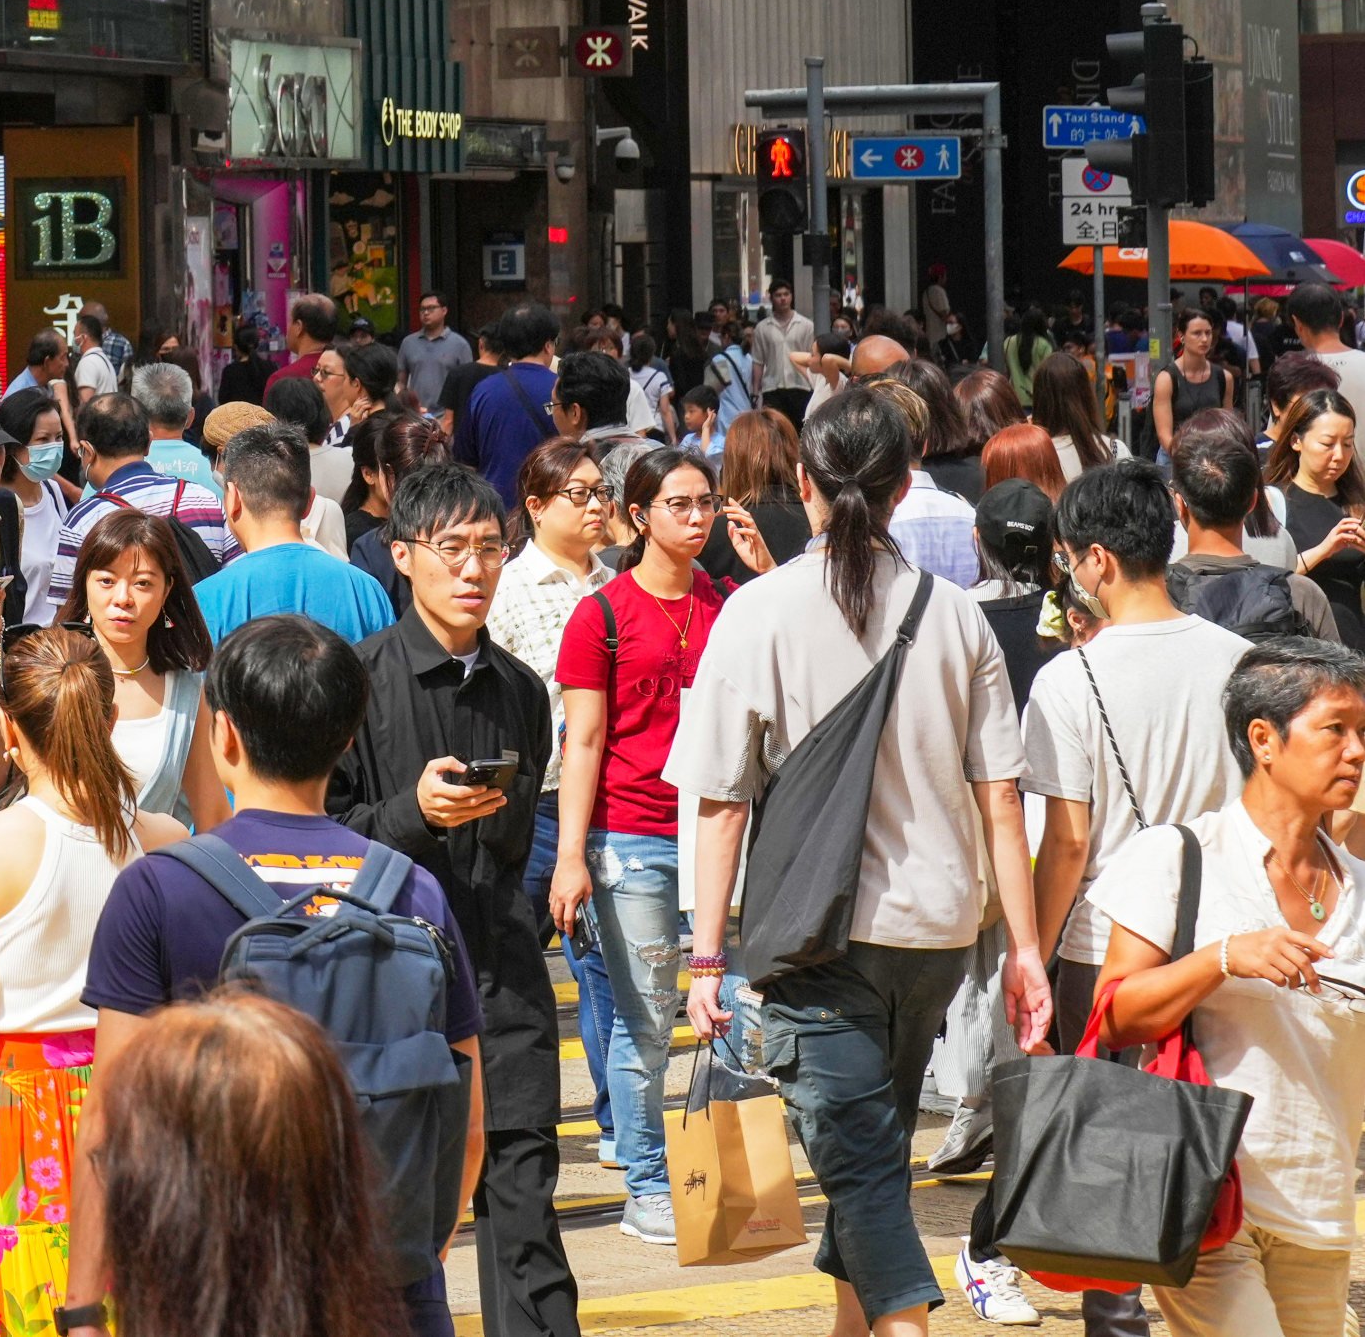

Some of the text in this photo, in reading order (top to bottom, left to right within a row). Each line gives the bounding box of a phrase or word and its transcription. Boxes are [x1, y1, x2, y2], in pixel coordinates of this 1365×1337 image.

[397, 109, 461, 140] THE BODY SHOP
[1065, 113, 1125, 123] Taxi Stand
[1070, 203, 1092, 216] 24
[1076, 221, 1117, 240] 全日
